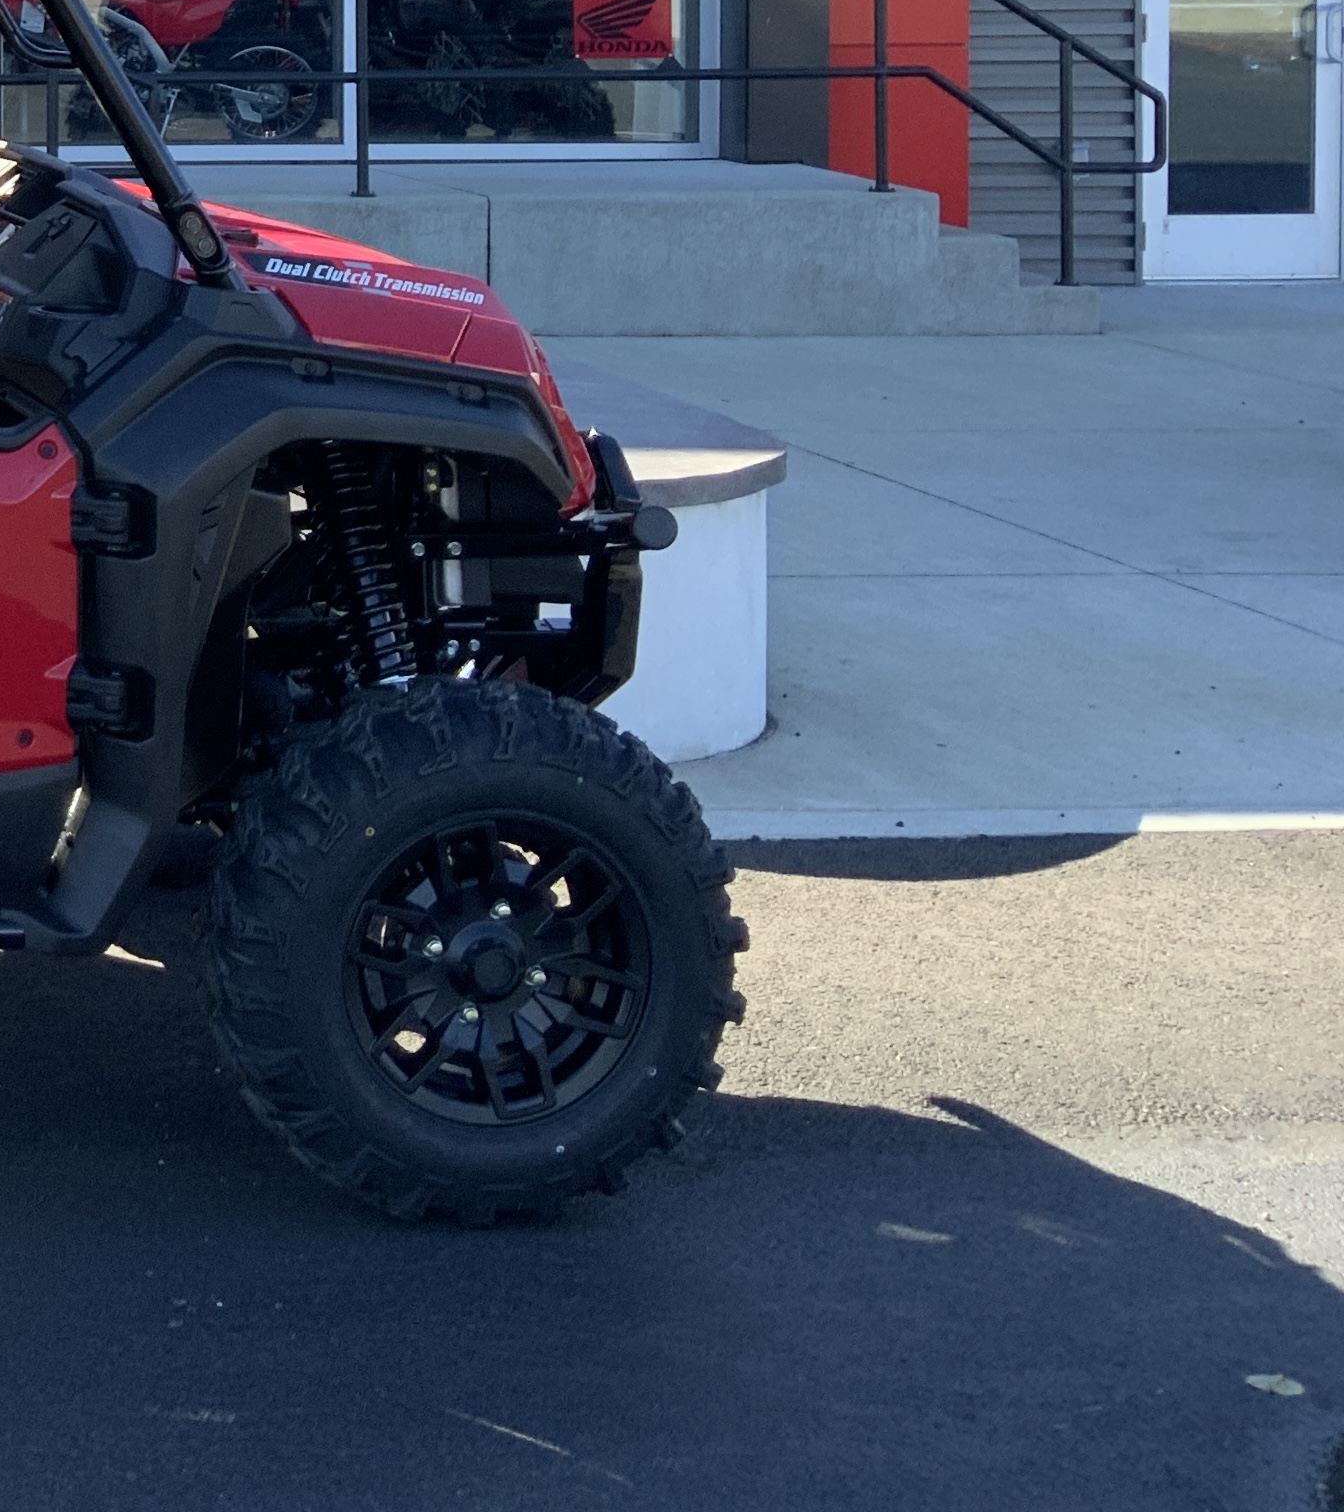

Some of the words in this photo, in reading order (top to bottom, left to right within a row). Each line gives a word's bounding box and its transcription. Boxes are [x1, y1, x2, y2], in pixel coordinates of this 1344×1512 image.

[577, 39, 669, 54] HONDA
[264, 257, 311, 279] Dual
[312, 264, 372, 286] Clutch
[374, 272, 485, 305] Transmission
